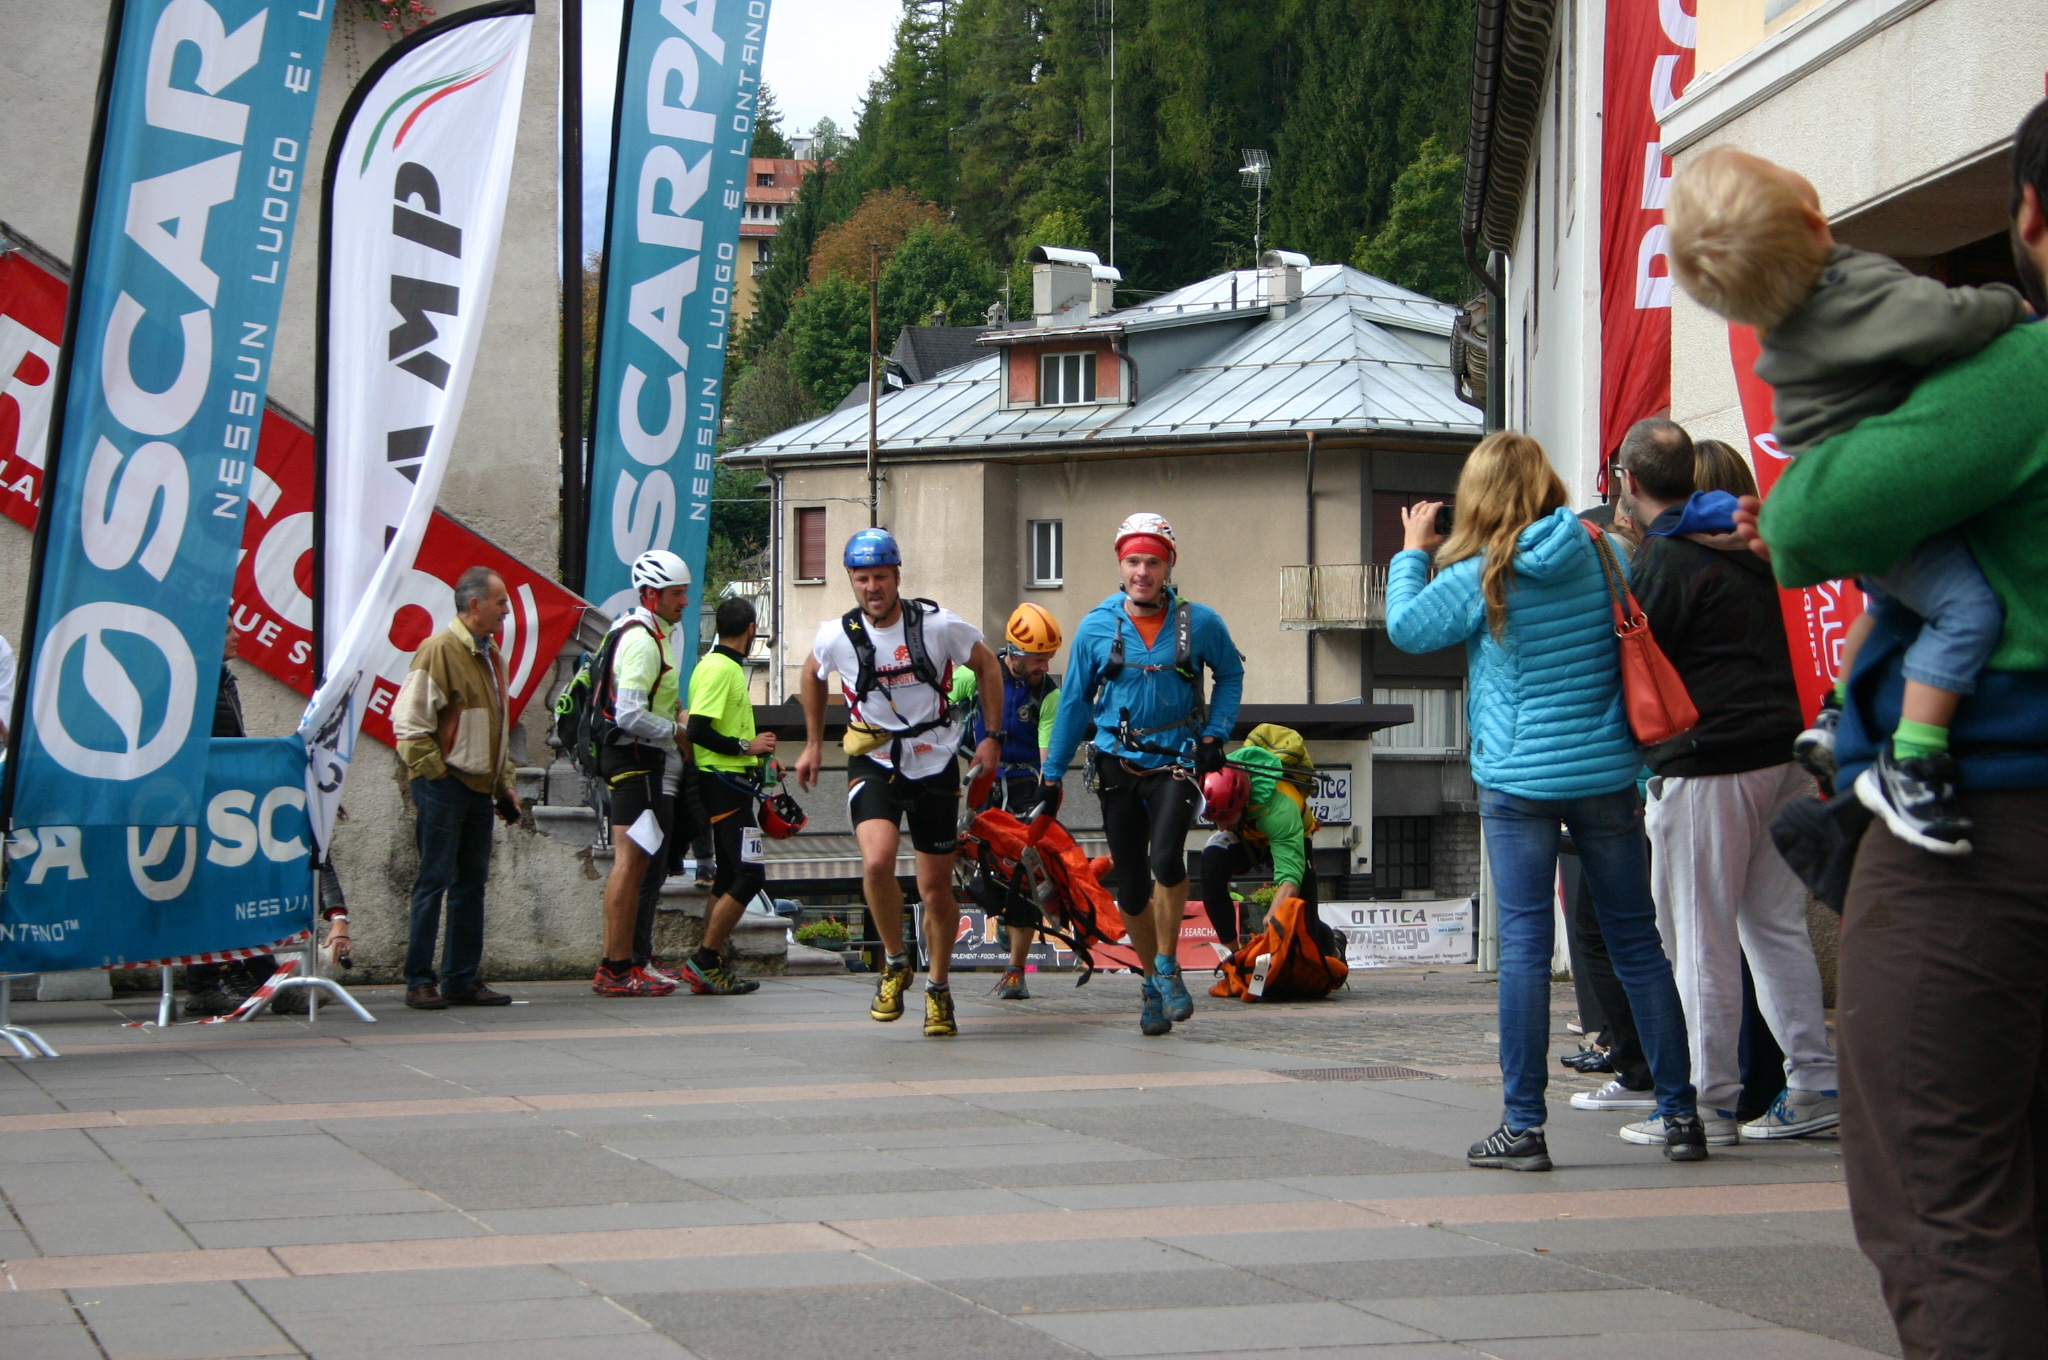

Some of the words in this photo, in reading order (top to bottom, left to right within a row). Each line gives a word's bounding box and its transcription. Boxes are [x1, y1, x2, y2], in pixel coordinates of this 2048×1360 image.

[212, 321, 268, 519] NESSUN
[251, 137, 299, 284] LUOGO
[385, 162, 462, 553] AMP
[612, 0, 725, 566] SCARPA
[690, 377, 718, 521] NESSUN
[707, 241, 734, 349] LUOGO
[730, 0, 766, 156] LONTANO
[750, 839, 762, 854] 16
[1351, 908, 1428, 925] OTTICA
